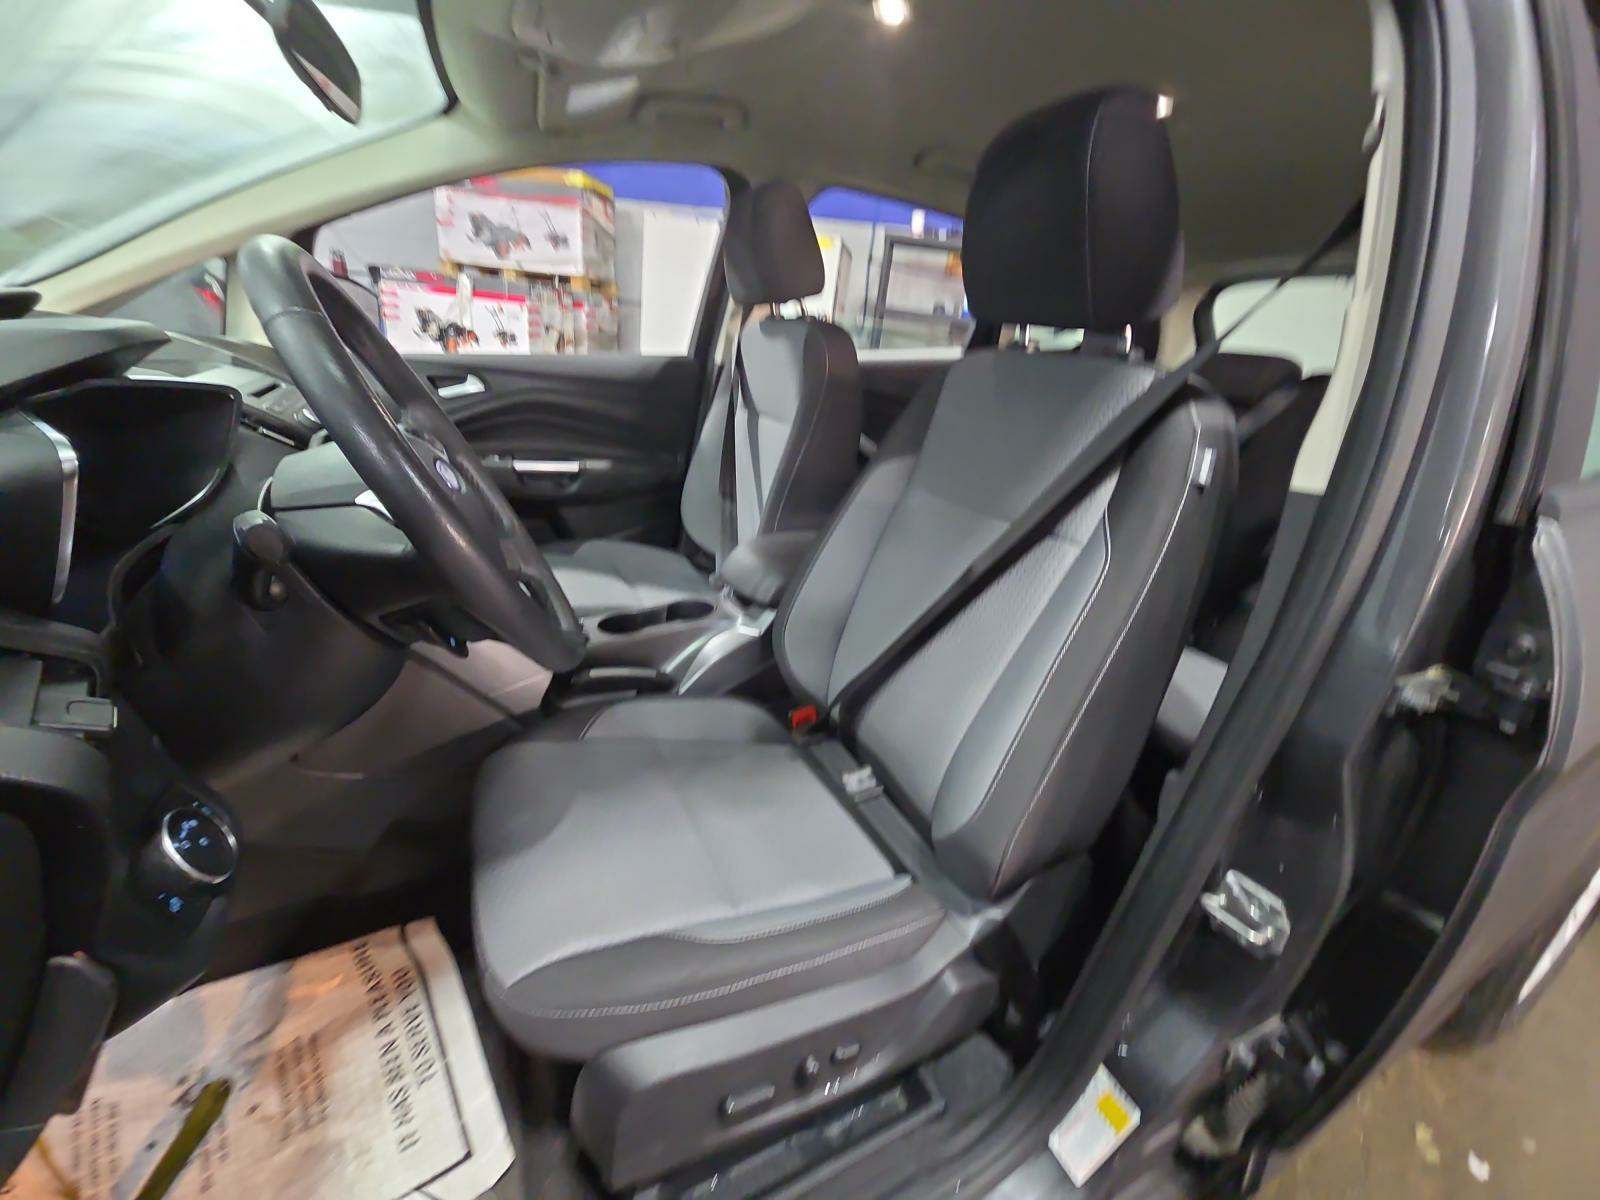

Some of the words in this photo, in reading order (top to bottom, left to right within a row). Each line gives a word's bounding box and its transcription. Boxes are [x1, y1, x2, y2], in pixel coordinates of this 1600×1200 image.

[391, 967, 417, 1004] YOU
[374, 1021, 395, 1039] A
[402, 1004, 431, 1061] SERVE
[415, 1060, 438, 1088] TO
[387, 1085, 413, 1129] HAS
